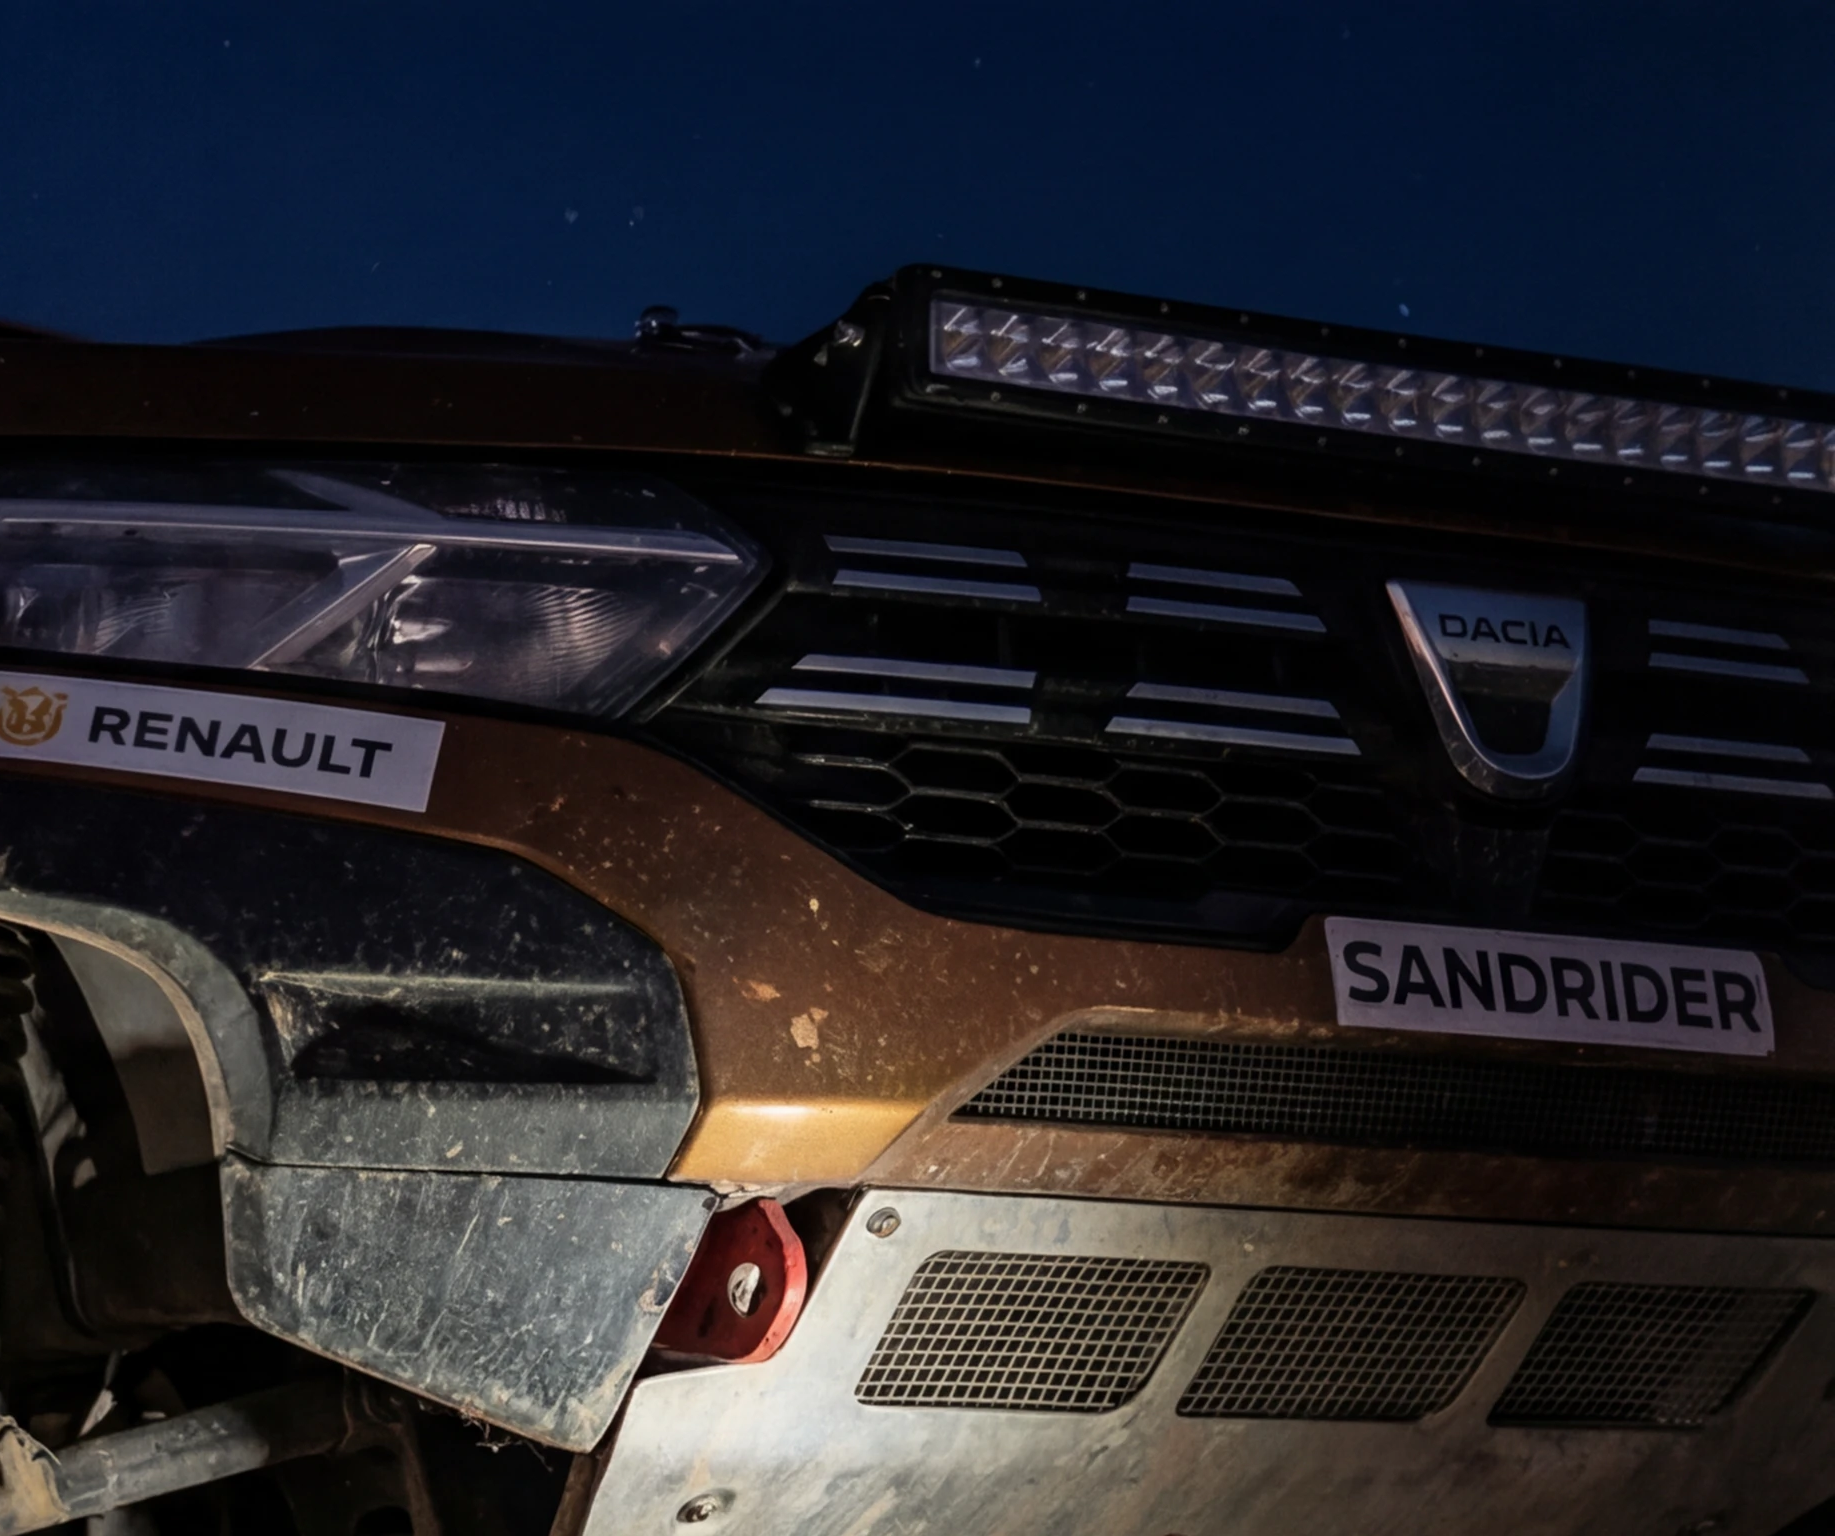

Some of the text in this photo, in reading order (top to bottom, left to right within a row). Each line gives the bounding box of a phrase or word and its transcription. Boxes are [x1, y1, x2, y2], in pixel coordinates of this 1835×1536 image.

[1437, 612, 1572, 650] DACIA
[87, 704, 394, 781] RENAULT
[1341, 939, 1762, 1034] SANDRIDER
